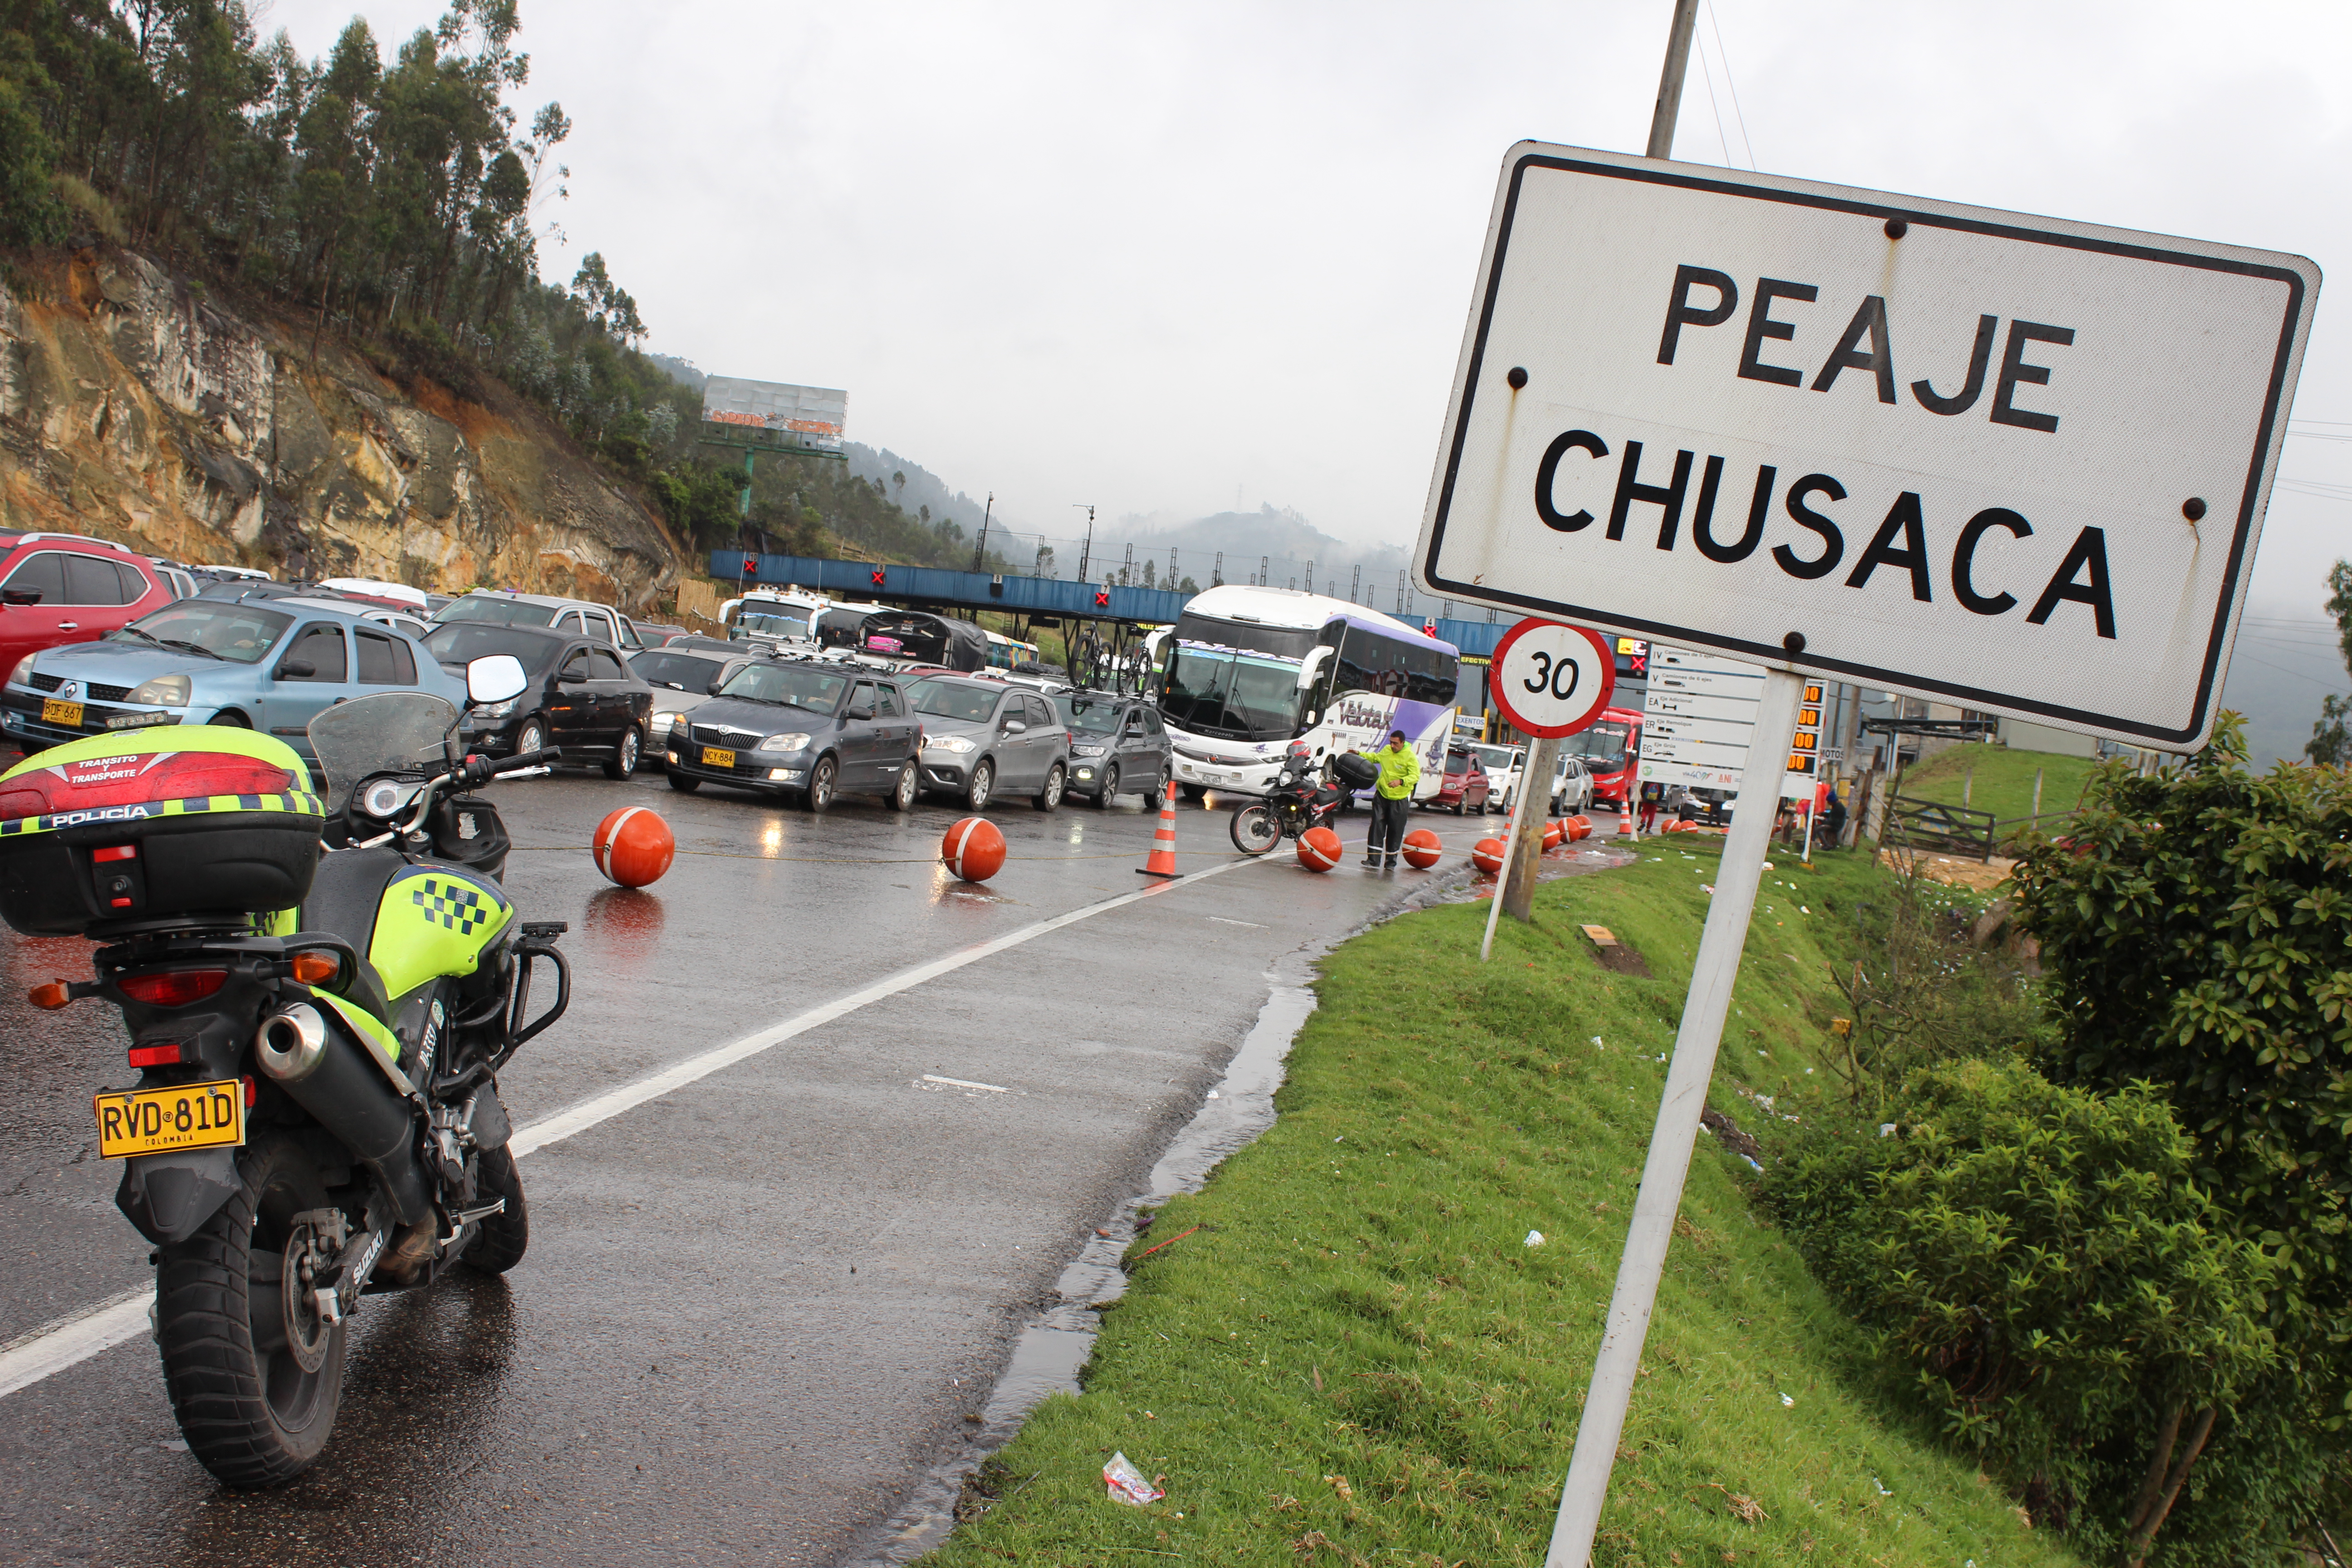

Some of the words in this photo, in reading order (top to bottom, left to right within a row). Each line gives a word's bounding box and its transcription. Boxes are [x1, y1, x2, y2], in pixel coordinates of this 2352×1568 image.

[1656, 264, 2075, 433] PEAJE
[1535, 430, 2116, 640] CHUSACA
[1653, 651, 1662, 659] IV
[1524, 652, 1579, 700] 30
[1649, 697, 1659, 706] EA
[1338, 700, 1394, 730] Velotax
[1457, 717, 1485, 725] EXENTOS
[1798, 709, 1816, 725] 00
[1646, 720, 1655, 729] ER
[1204, 729, 1234, 738] Marcopolo
[1793, 733, 1814, 749] 00
[1642, 744, 1652, 753] EG
[78, 755, 137, 769] TRANSITO
[1788, 755, 1806, 770] 00
[71, 769, 136, 784] TRANSPORTE
[52, 804, 150, 828] POLICÍA
[146, 1134, 194, 1146] COLOMBIA
[352, 1230, 384, 1285] SUZUKI
